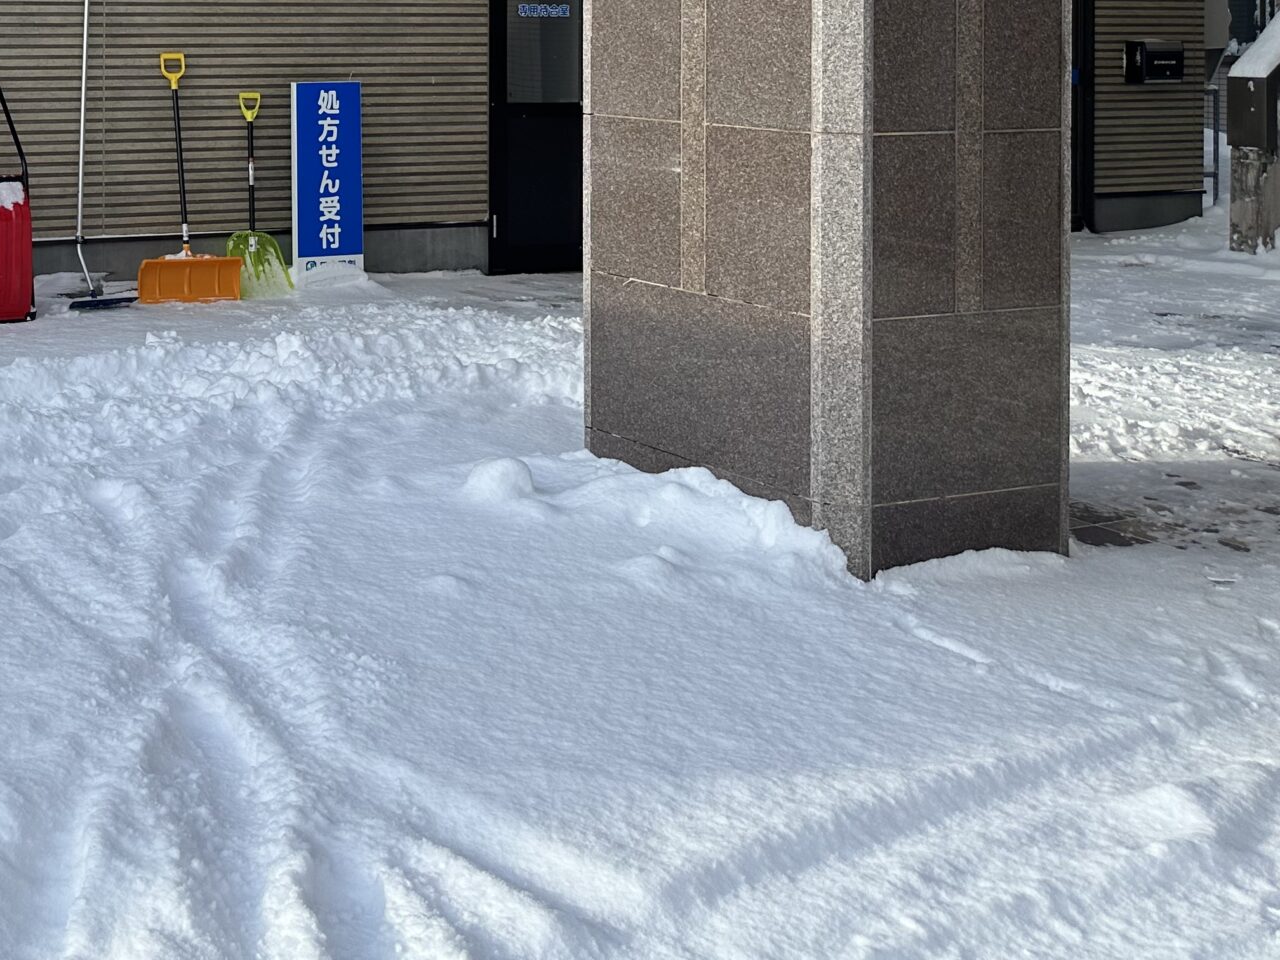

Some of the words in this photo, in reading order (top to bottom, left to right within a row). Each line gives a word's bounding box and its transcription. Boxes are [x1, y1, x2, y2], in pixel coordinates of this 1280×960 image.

[518, 4, 570, 17] 専用待合室
[317, 89, 342, 250] 処方せん受付
